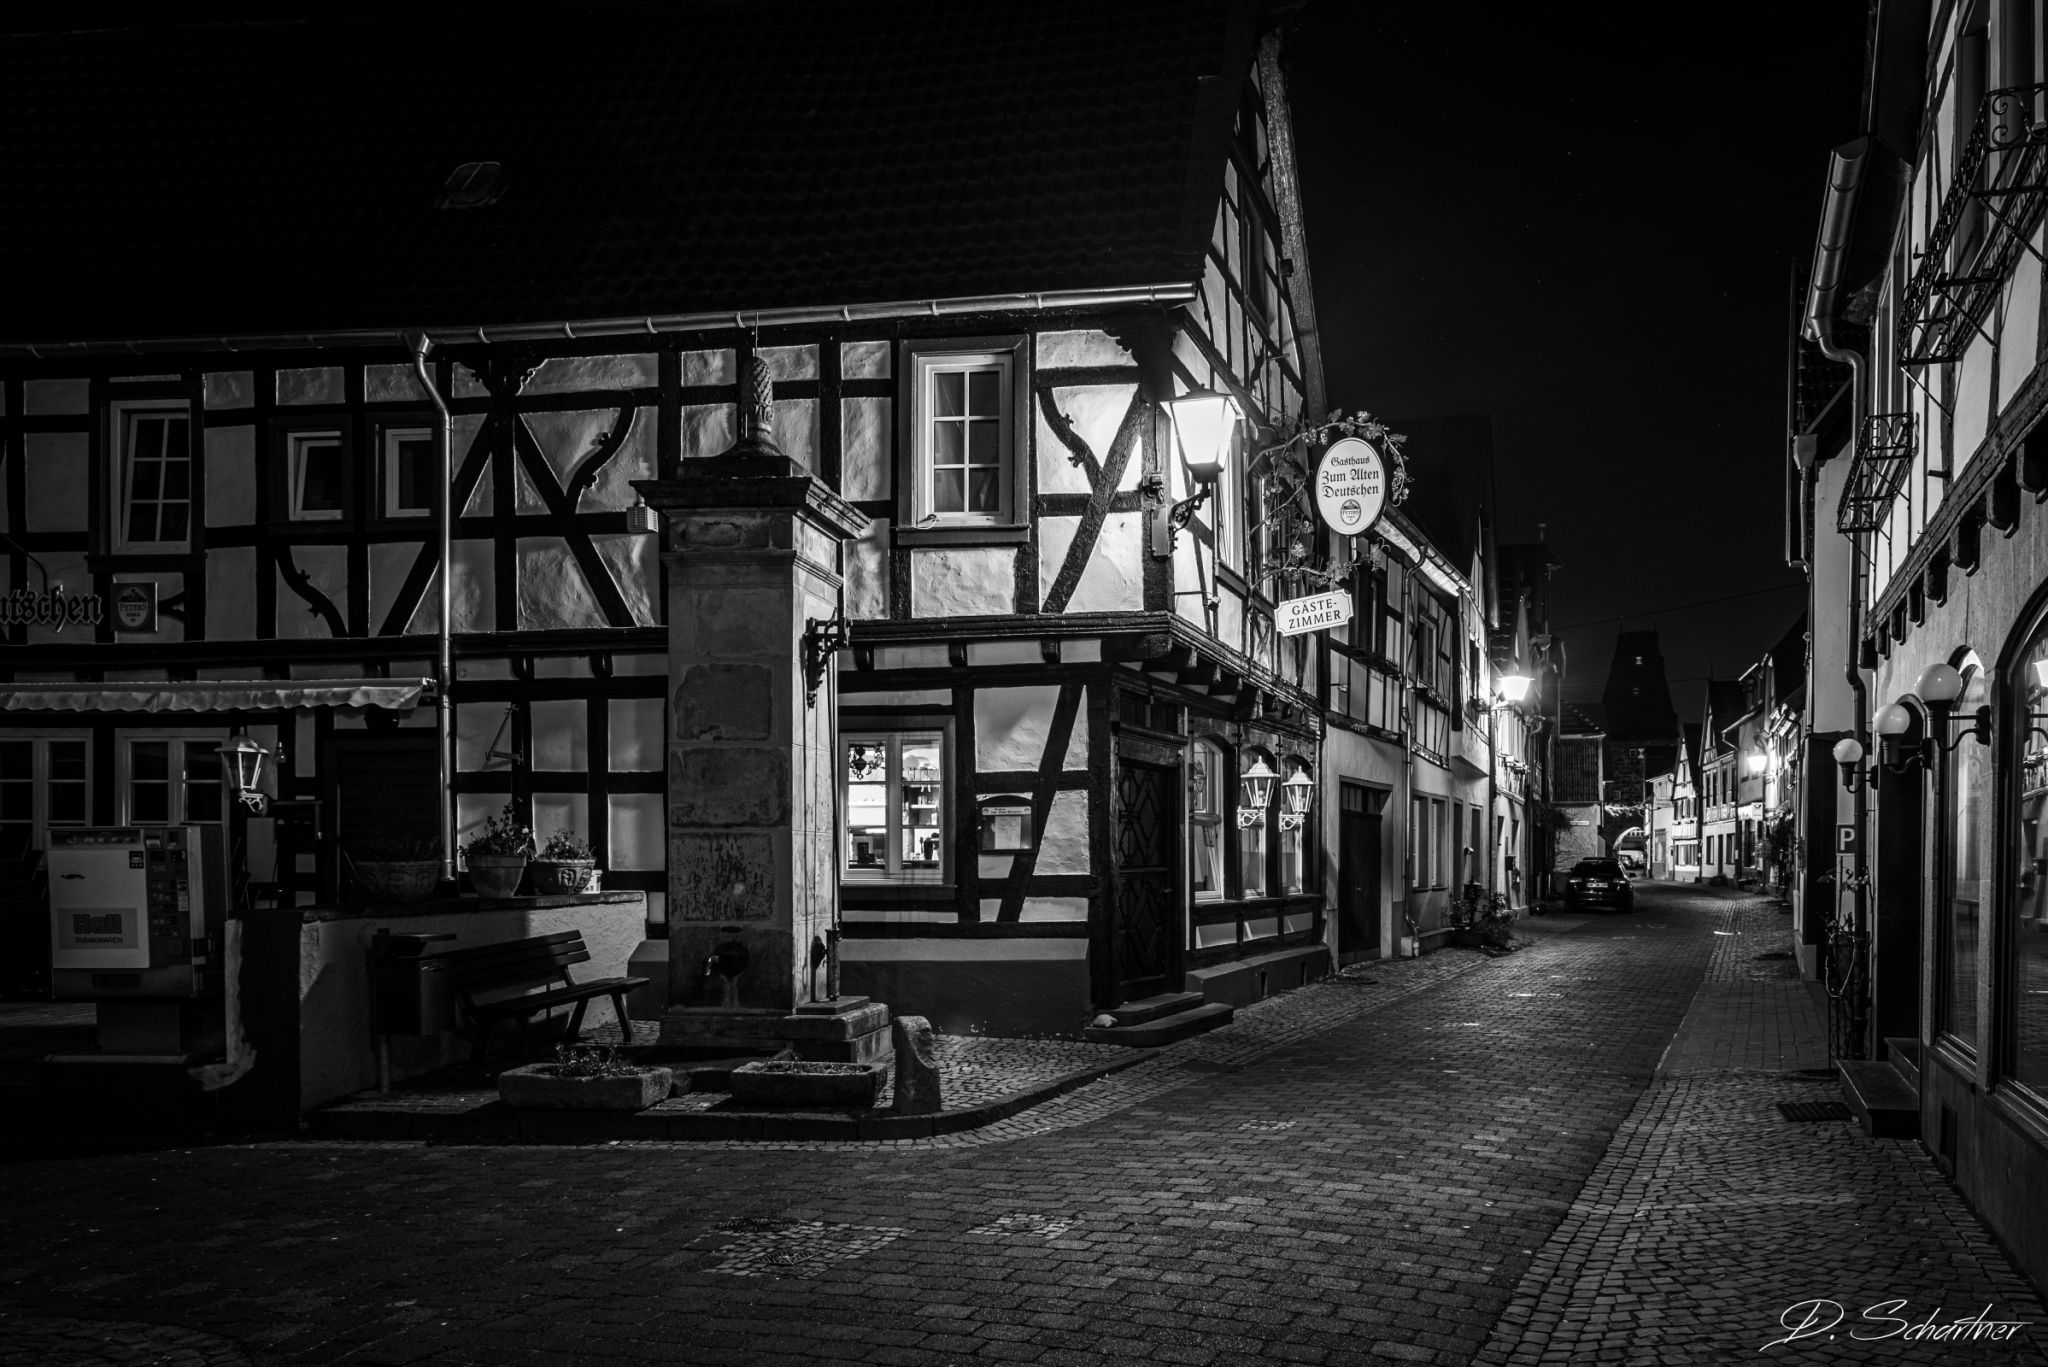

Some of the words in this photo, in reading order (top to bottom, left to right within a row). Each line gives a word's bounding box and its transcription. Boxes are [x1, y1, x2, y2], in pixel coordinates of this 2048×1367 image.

[1330, 455, 1370, 467] Gasthaus
[1321, 470, 1346, 485] Zum
[1349, 468, 1380, 481] Alten
[1322, 483, 1379, 498] Deutschen
[1291, 598, 1337, 616] GÄSTE-
[1288, 609, 1341, 629] ZIMMER
[1840, 827, 1855, 851] P
